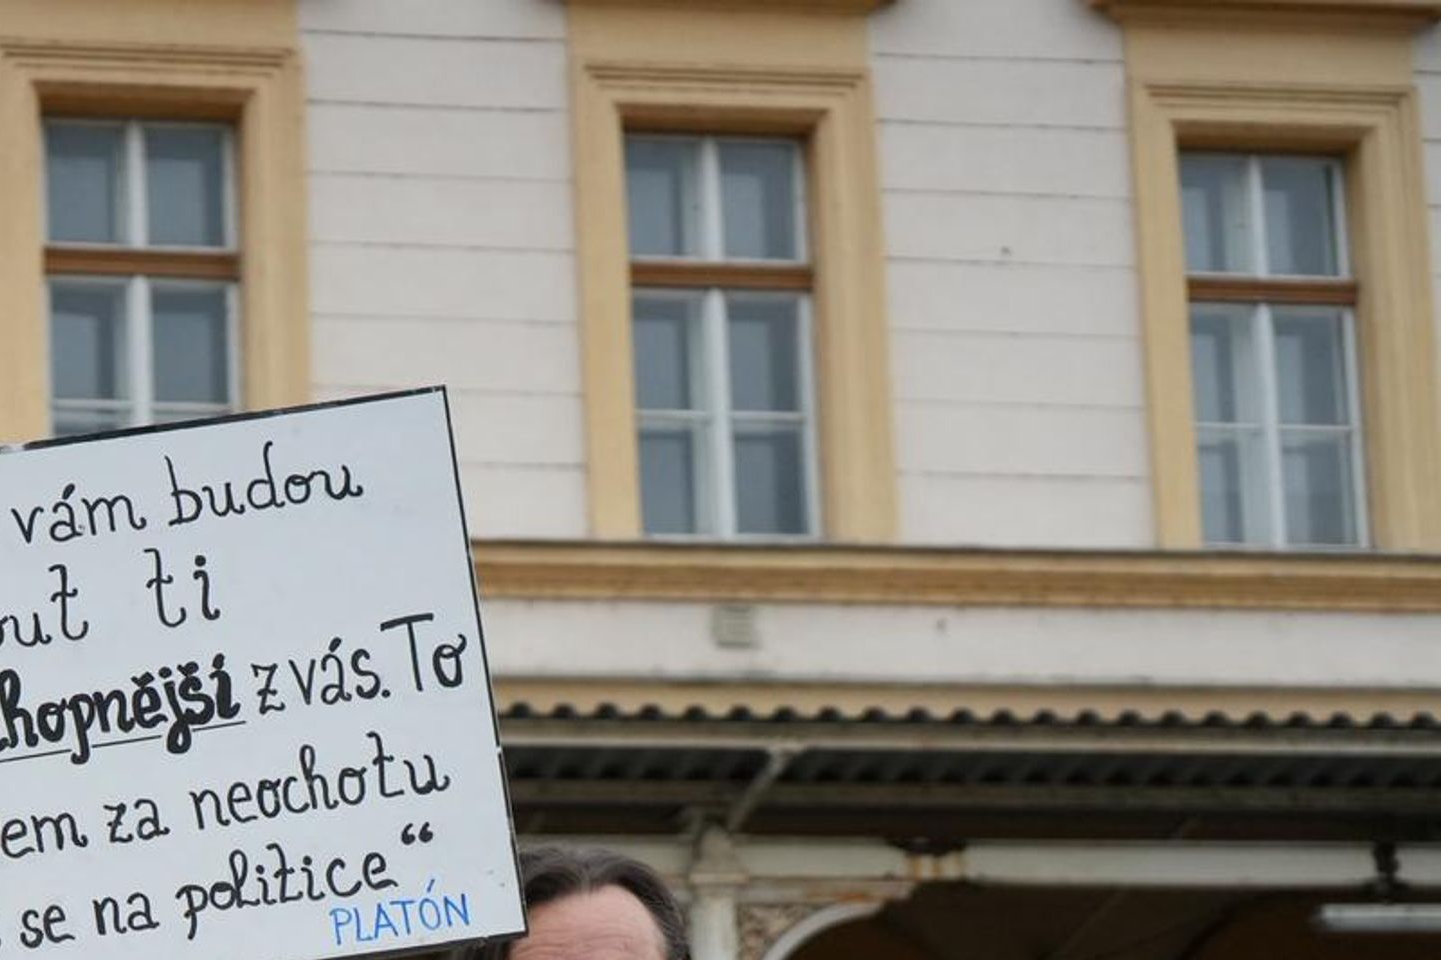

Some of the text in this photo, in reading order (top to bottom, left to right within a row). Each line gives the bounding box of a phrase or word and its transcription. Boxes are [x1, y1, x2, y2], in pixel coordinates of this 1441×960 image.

[11, 483, 147, 544] vám
[164, 441, 364, 527] budou
[143, 547, 221, 628] ti
[379, 612, 468, 692] To
[103, 798, 170, 843] za
[188, 731, 450, 830] neochotu
[20, 904, 75, 949] se
[92, 892, 160, 935] na
[329, 879, 471, 946] PLATÓN
